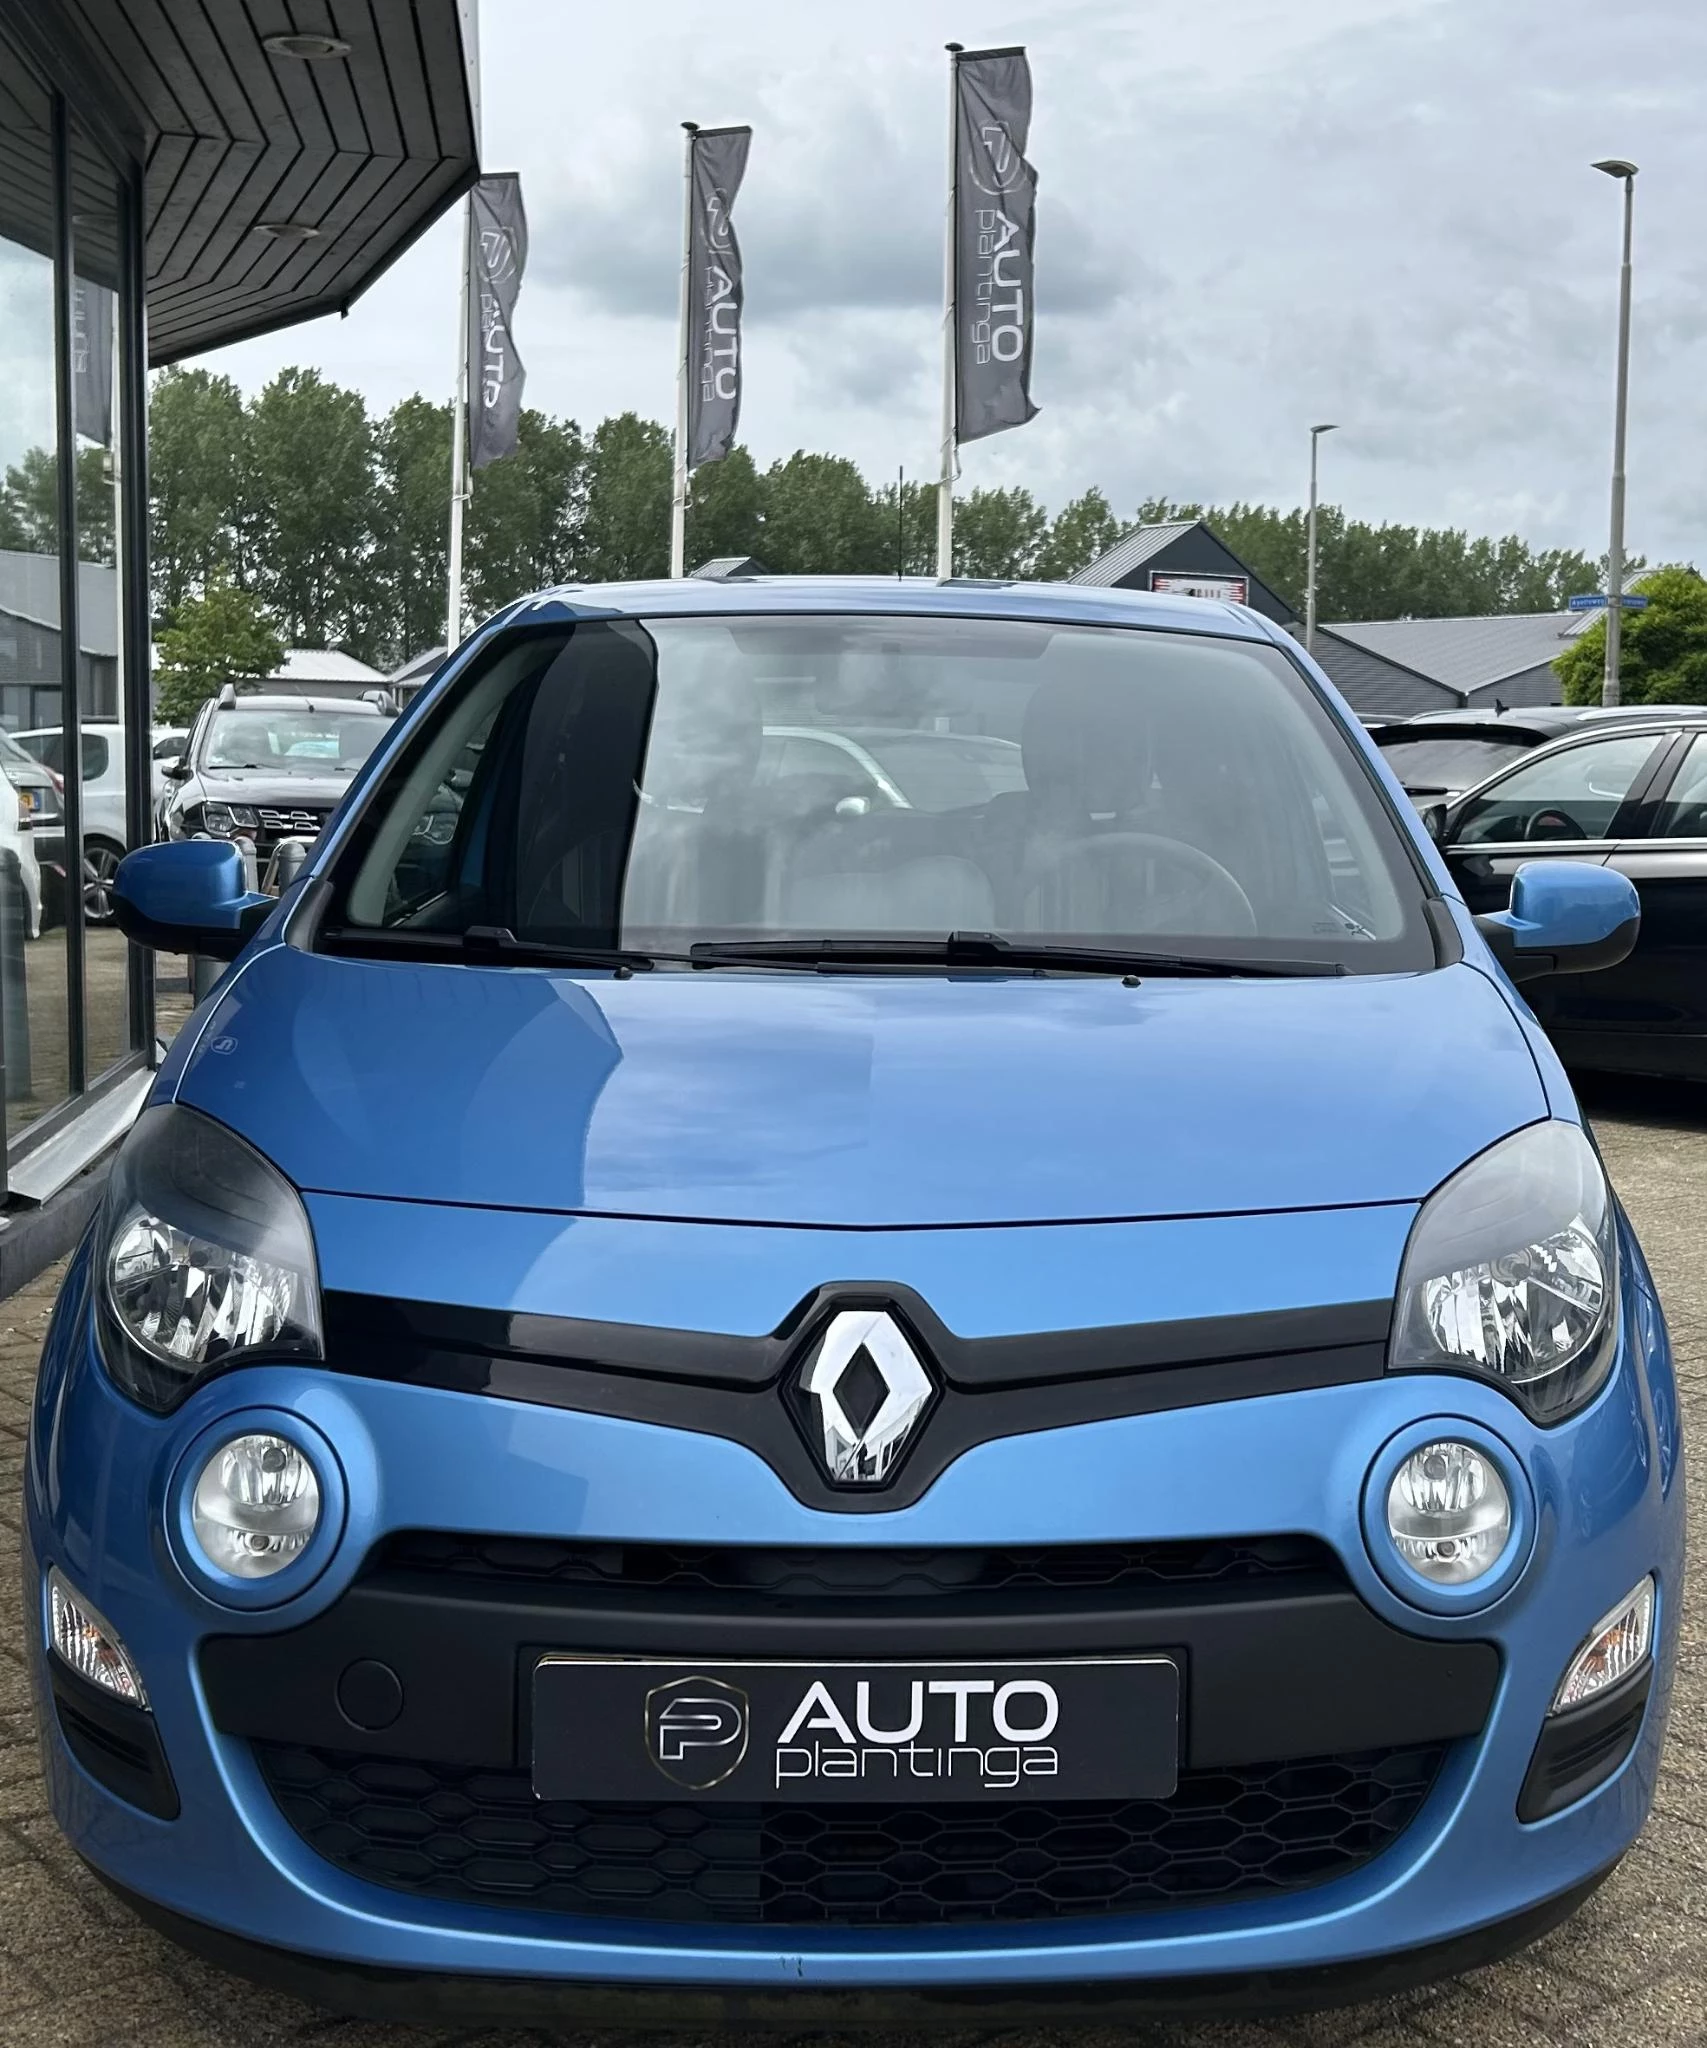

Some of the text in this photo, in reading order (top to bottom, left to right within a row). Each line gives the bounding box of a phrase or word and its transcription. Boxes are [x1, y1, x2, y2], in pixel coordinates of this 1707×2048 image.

[711, 264, 739, 400] AUTO
[971, 207, 997, 365] plantinga
[991, 208, 1025, 362] AUTO
[775, 1740, 1059, 1789] plantinga
[777, 1680, 1060, 1745] AUTO
